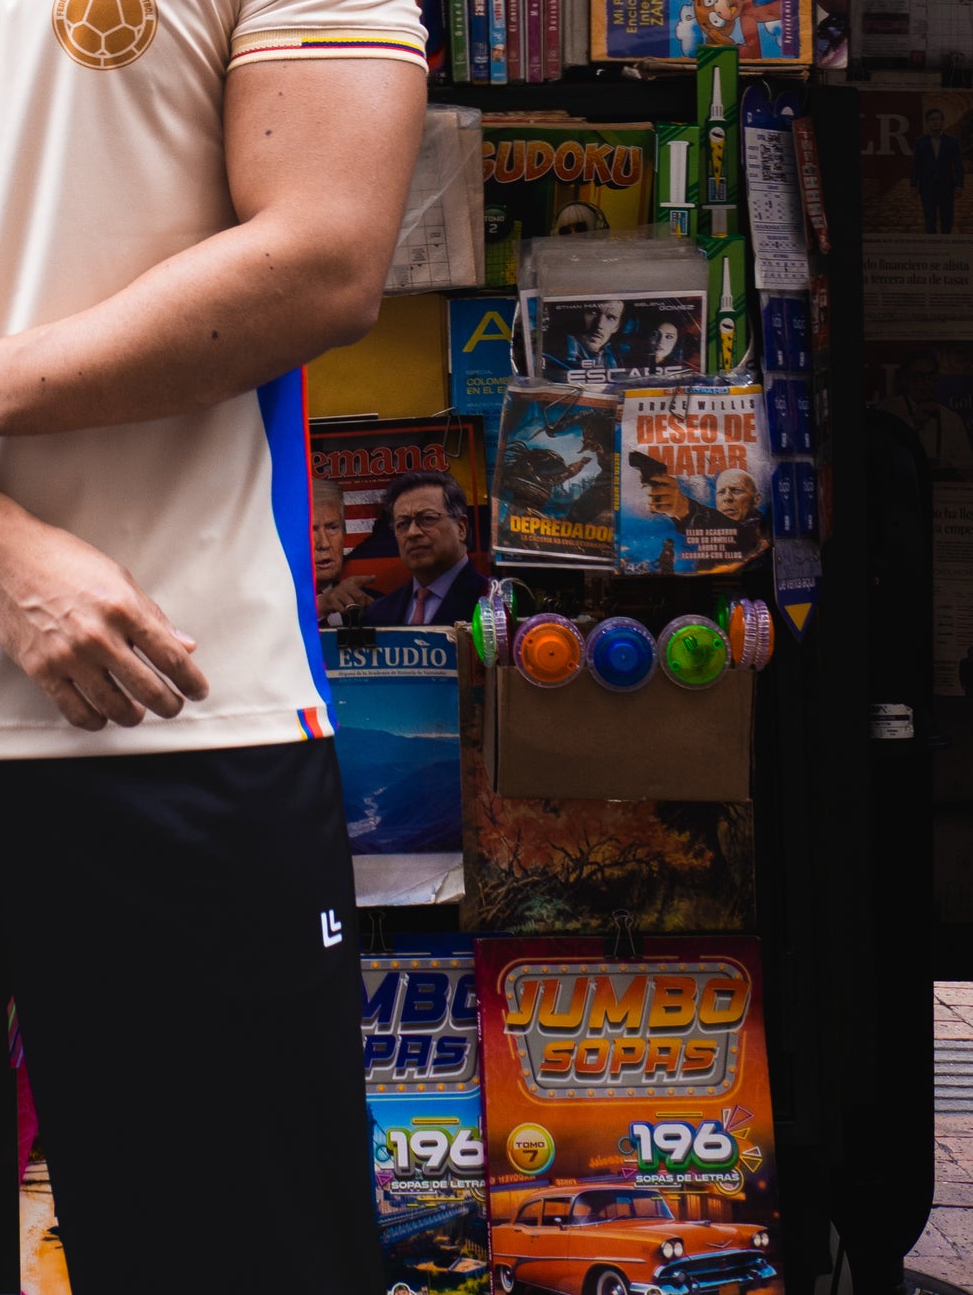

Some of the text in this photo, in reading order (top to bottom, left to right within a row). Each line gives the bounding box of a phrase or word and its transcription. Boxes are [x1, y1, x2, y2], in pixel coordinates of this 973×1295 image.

[614, 10, 624, 25] Mi
[482, 139, 643, 187] SUDOKU
[489, 223, 498, 234] 2
[879, 259, 969, 272] financiero se alista
[871, 273, 969, 285] tercera alza de tasas
[582, 360, 604, 369] EL
[467, 387, 480, 395] EN
[638, 399, 755, 412] BRUCE WILLIS
[637, 413, 757, 444] DESEO DE
[648, 444, 748, 476] MATAR
[339, 646, 447, 667] ESTUDIO
[505, 975, 750, 1031] JUMBO
[540, 1038, 718, 1075] SOPAS
[516, 1141, 545, 1149] TOMO
[632, 1122, 735, 1161] 196
[387, 1126, 486, 1171] 196
[526, 1150, 538, 1162] 7
[391, 1180, 427, 1190] SOPAS
[429, 1180, 448, 1189] DE
[636, 1172, 739, 1185] SOPAS DE LETRAS
